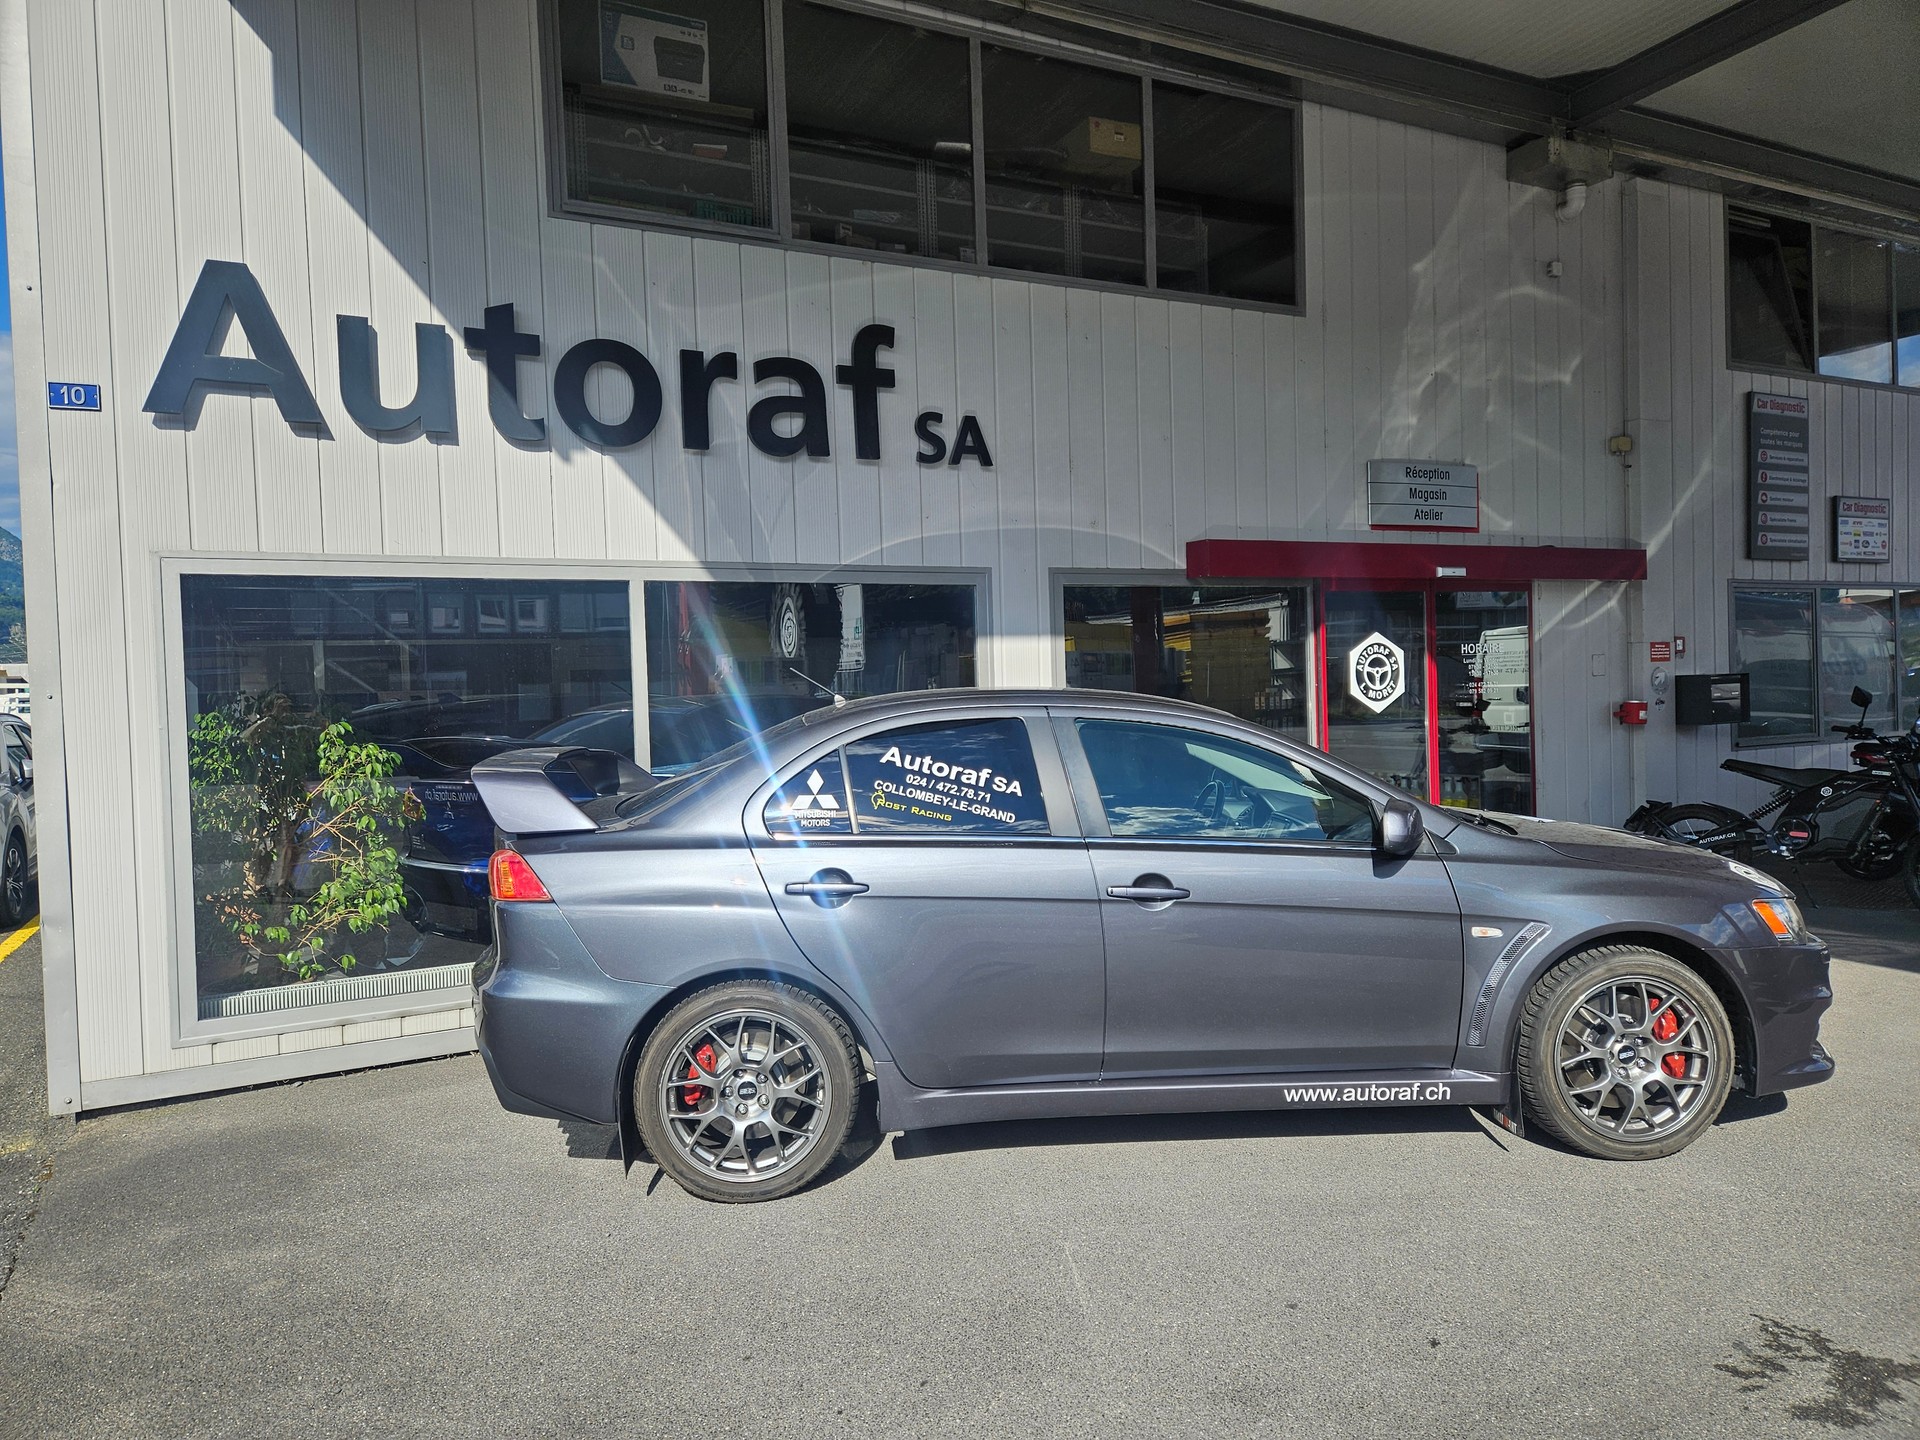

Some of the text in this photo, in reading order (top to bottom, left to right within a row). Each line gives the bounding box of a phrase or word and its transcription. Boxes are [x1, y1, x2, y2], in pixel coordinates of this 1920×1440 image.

[142, 259, 994, 466] Autoraf SA
[60, 385, 86, 405] 10
[1756, 398, 1806, 414] Car Diagnostic
[1405, 466, 1450, 482] Réception
[1409, 487, 1447, 503] Magasin
[1414, 508, 1444, 522] Atelier
[1842, 501, 1887, 516] Car Diagnostic
[1357, 644, 1399, 671] AUTORAF SA
[1360, 680, 1396, 699] L. MORET
[879, 746, 1023, 797] Autoraf SA
[905, 774, 992, 803] 024 / 472.78.71
[873, 780, 1016, 824] COLLOMBEY-LE-GRAND
[795, 810, 837, 819] MITSUBISHI
[911, 806, 953, 822] RACING
[800, 819, 831, 827] MOTORS
[1698, 831, 1737, 845] AUTORAF.CH
[1283, 1082, 1451, 1103] www.autoraf.ch
